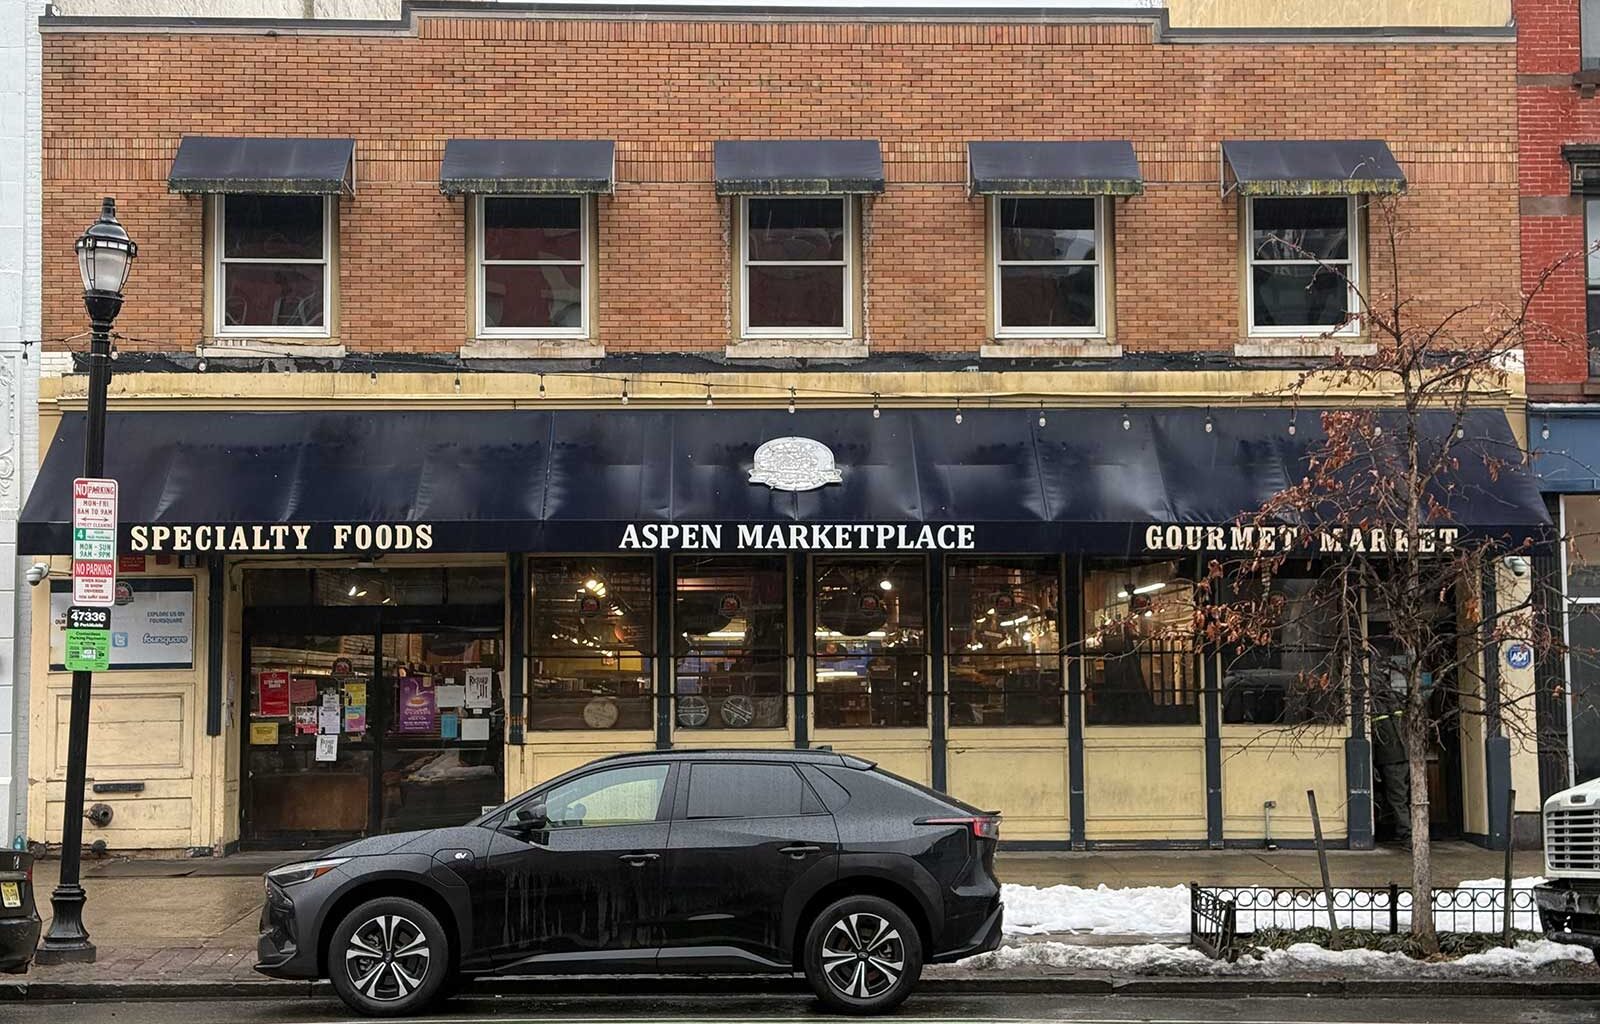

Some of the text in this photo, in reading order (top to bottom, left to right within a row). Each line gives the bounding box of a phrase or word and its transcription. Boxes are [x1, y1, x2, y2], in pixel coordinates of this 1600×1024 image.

[75, 483, 114, 496] NO PARKING
[77, 529, 84, 540] 4
[130, 524, 433, 551] SPECIALTY FOODS
[618, 524, 975, 549] ASPEN MARKETPLACE
[1145, 525, 1459, 553] GOURMET MARKET
[75, 563, 113, 576] NO PARKING
[71, 611, 106, 622] 47336
[143, 633, 188, 645] foursquare
[1510, 650, 1529, 662] ADT
